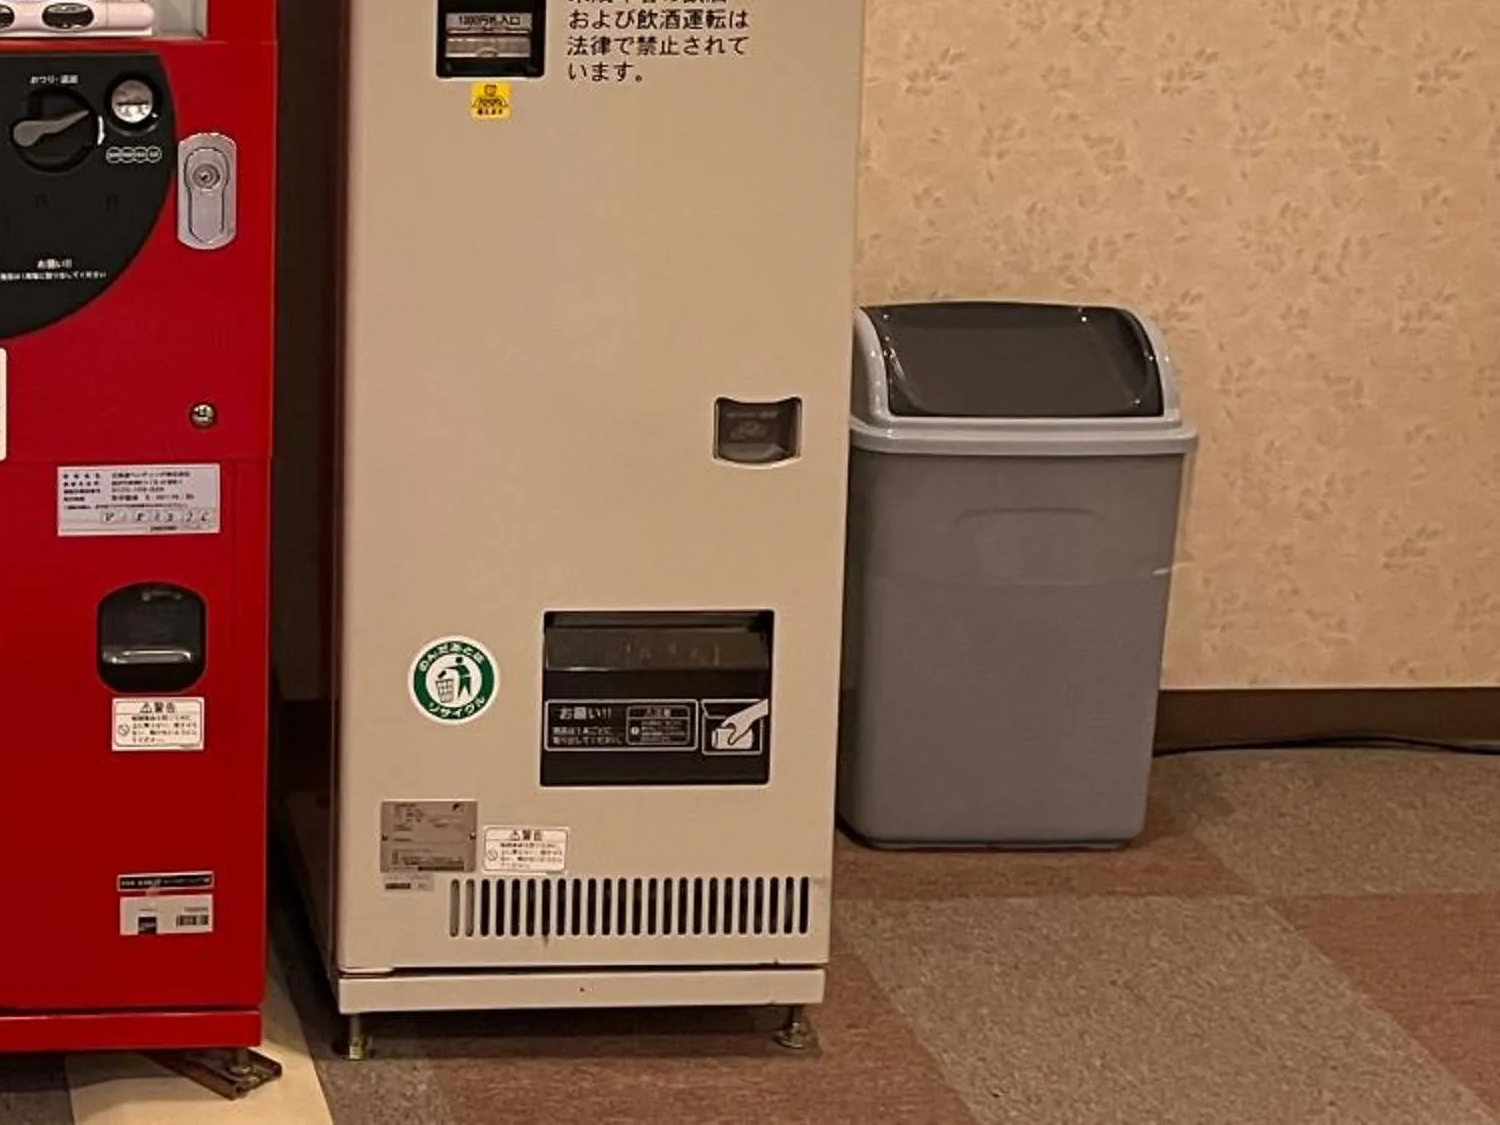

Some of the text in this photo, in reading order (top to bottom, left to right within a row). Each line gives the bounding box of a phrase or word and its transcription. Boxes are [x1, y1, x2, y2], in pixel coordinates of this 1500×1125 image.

[568, 8, 750, 32] および飲酒運転は
[566, 35, 750, 57] 法律で禁止されて
[567, 61, 645, 84] います。
[426, 695, 486, 720] リサイクル
